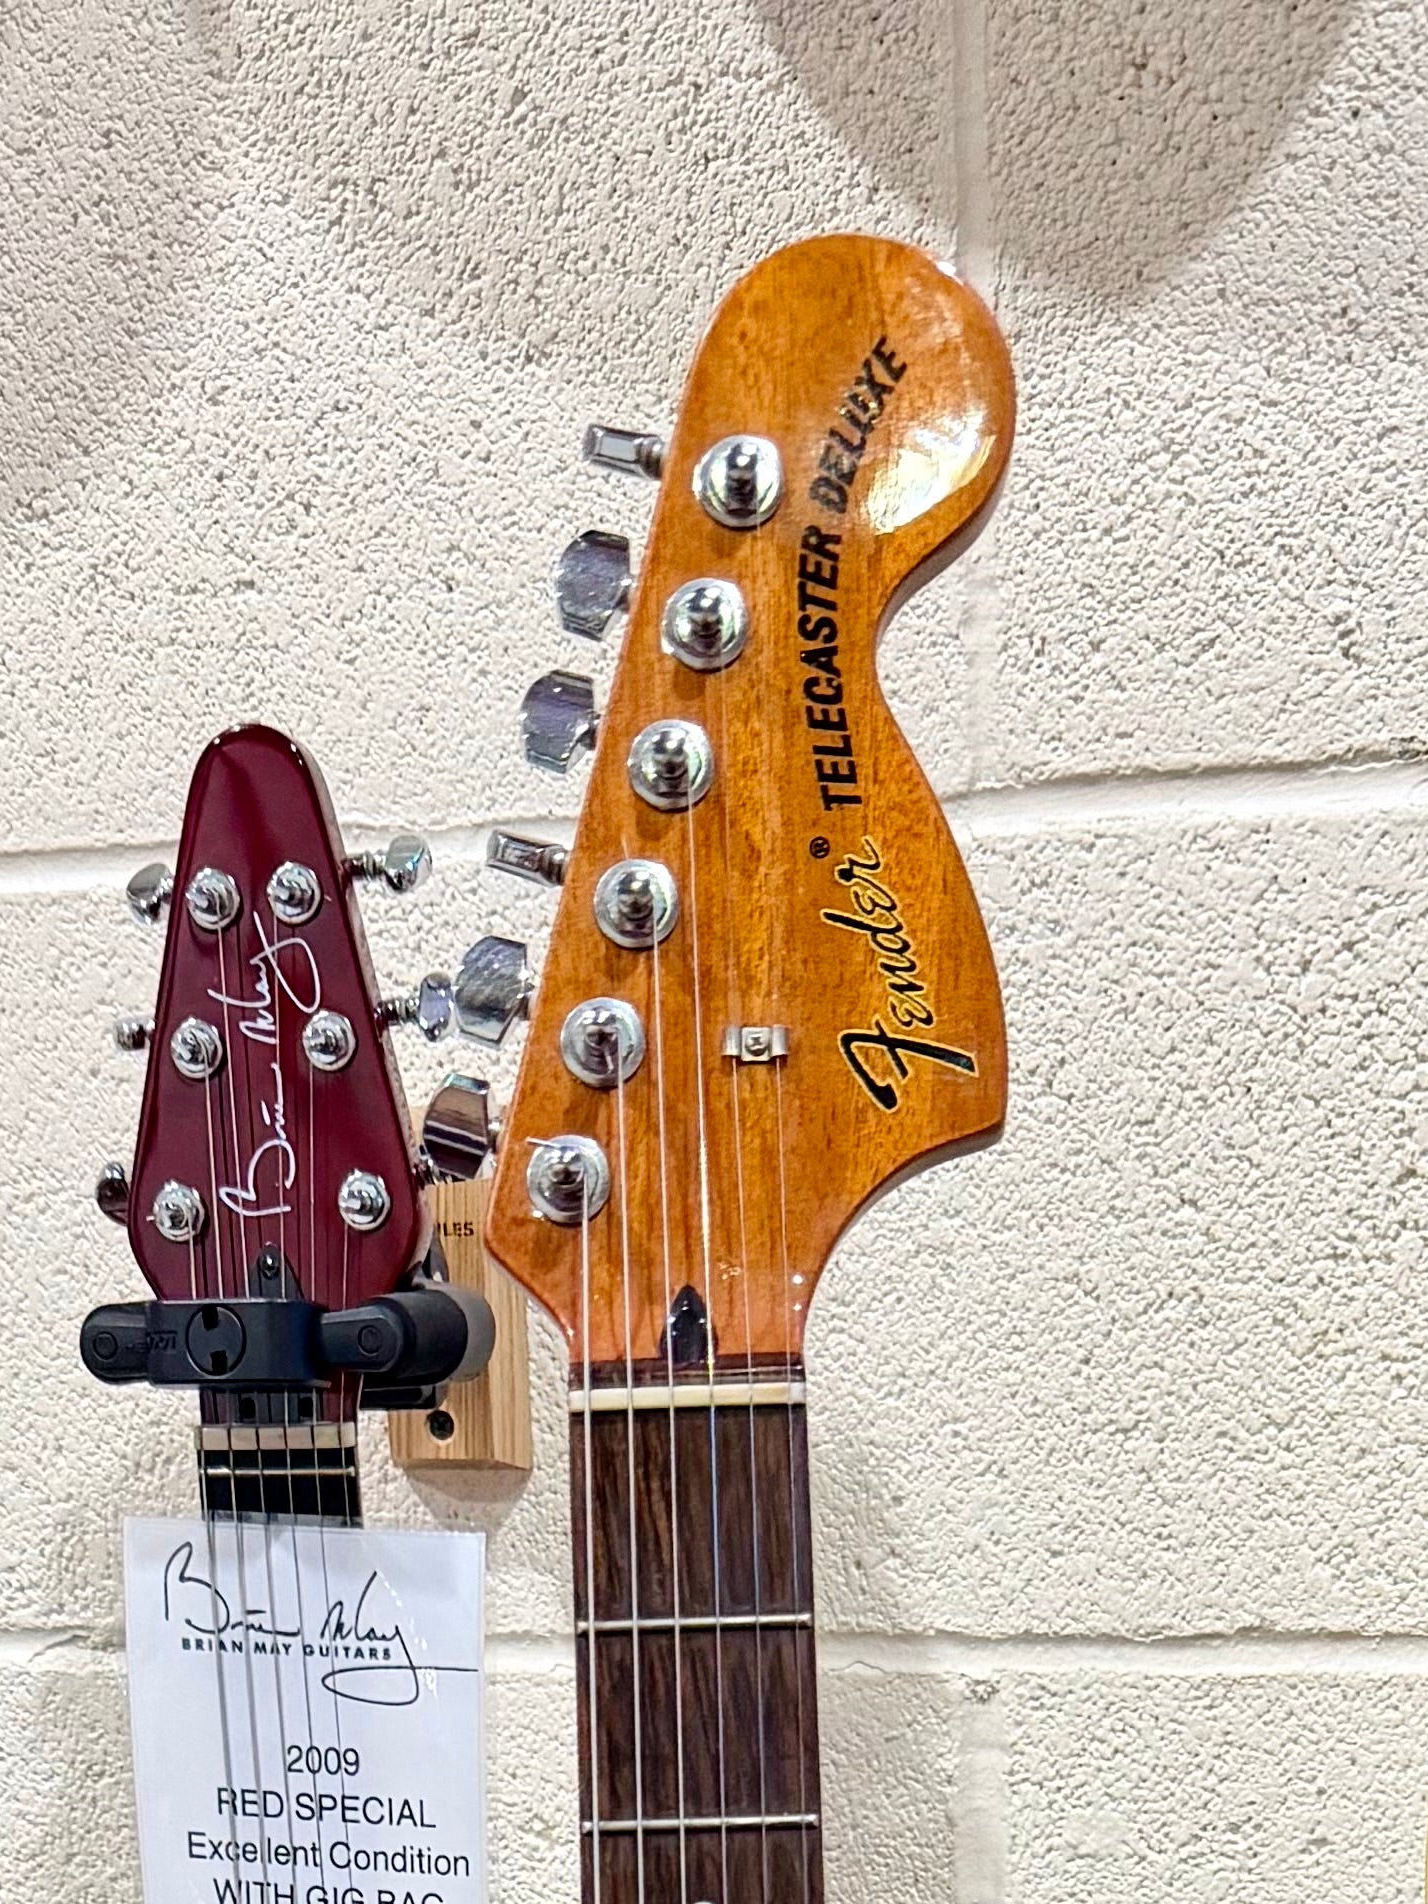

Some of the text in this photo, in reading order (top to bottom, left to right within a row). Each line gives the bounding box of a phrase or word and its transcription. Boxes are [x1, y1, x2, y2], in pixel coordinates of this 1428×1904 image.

[797, 335, 908, 812] TELECASTER DELUXE
[820, 834, 979, 1113] Fender
[181, 1638, 391, 1660] BRIAN MAY GUITARS
[286, 1745, 360, 1776] 2009
[217, 1787, 436, 1829] RED SPECIAL
[329, 1841, 470, 1877] Condition
